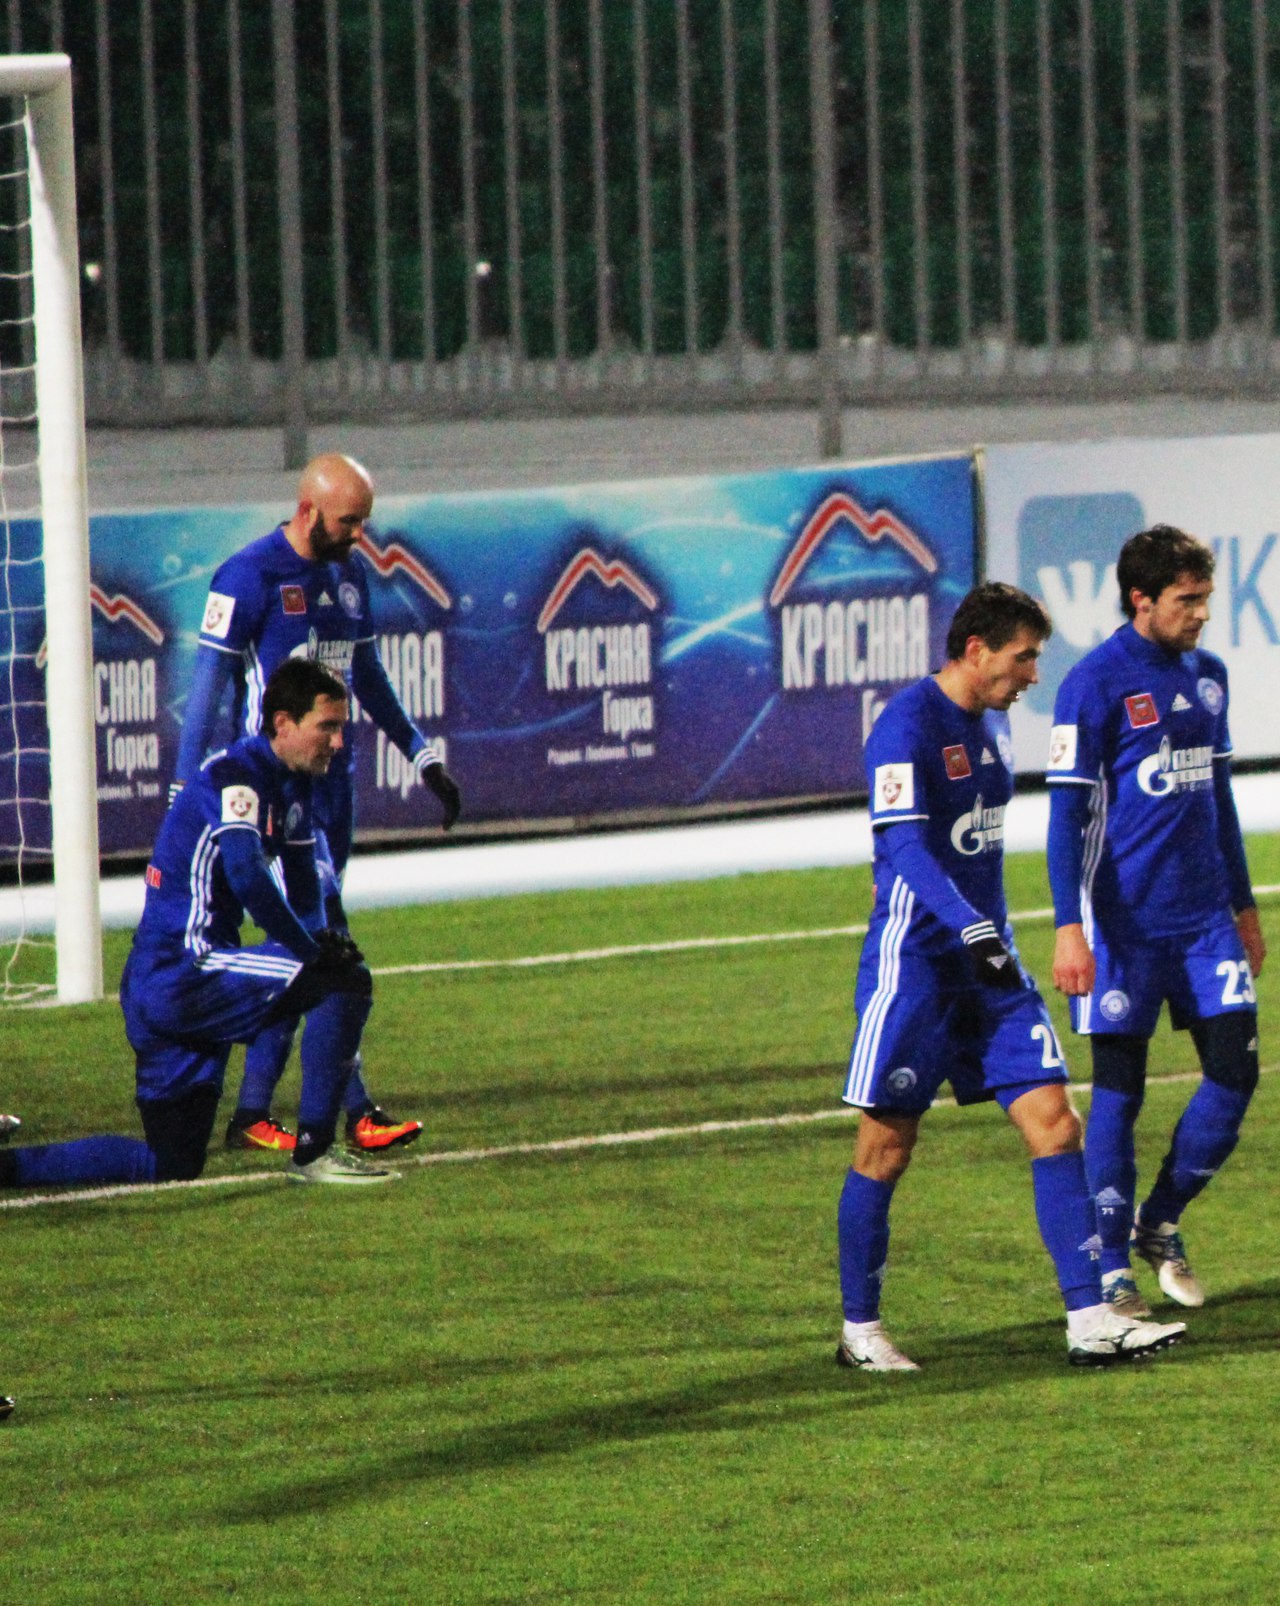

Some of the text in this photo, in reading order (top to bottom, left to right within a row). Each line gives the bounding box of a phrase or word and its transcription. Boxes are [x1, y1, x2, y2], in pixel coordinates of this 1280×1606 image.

[545, 622, 650, 690] КРАСНАЯ
[781, 592, 929, 690] КРАСНАЯ
[94, 657, 157, 726] СНАЯ
[602, 689, 654, 741] Горка
[106, 727, 159, 779] Горка
